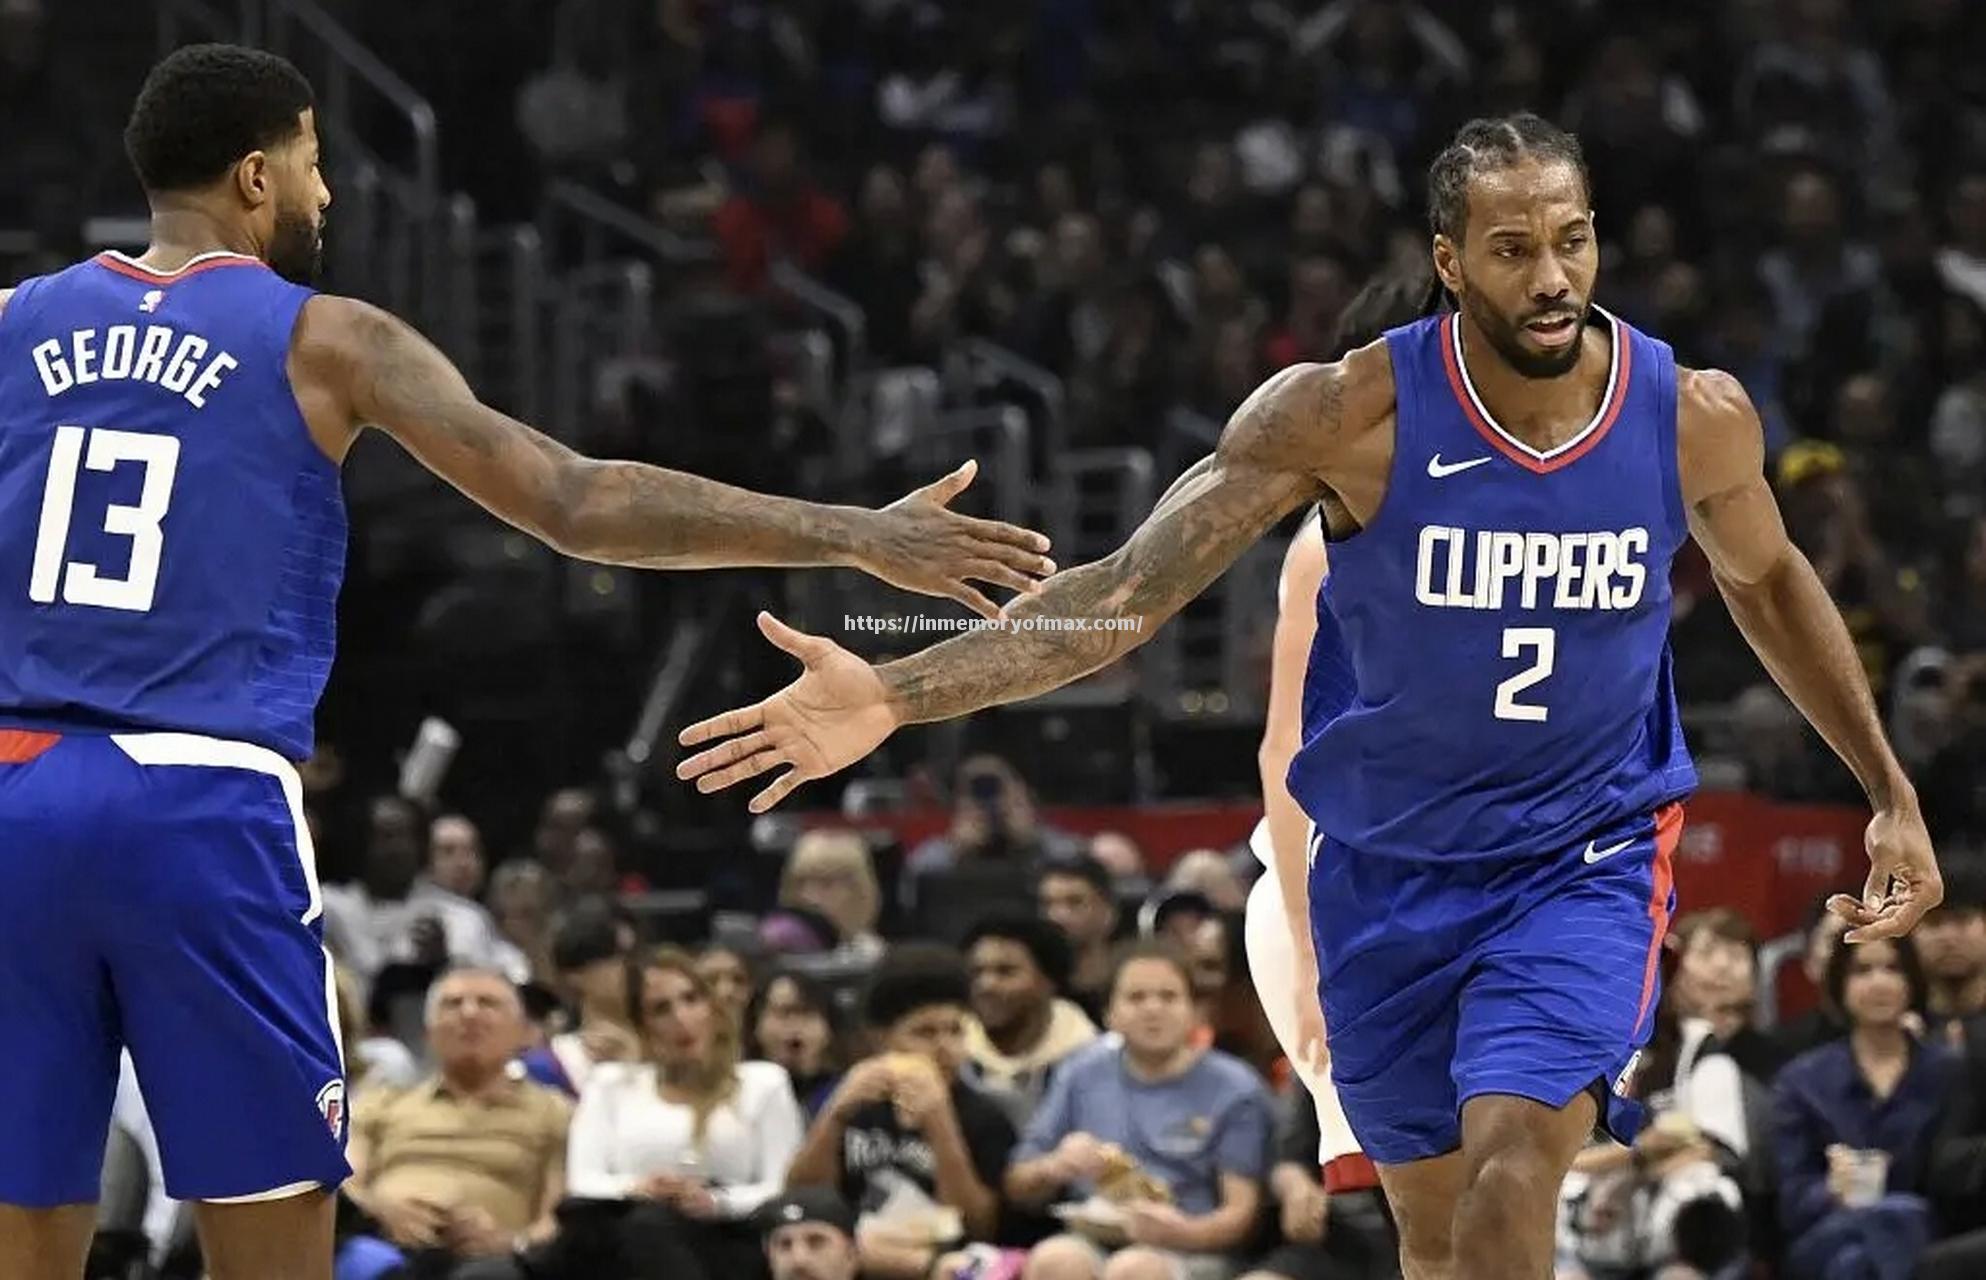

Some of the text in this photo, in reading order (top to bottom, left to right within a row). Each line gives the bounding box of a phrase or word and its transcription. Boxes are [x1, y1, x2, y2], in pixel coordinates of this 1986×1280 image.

[32, 325, 238, 409] GEORGE
[29, 425, 181, 612] 13
[1415, 525, 1649, 610] CLIPPERS
[1494, 627, 1555, 721] 2
